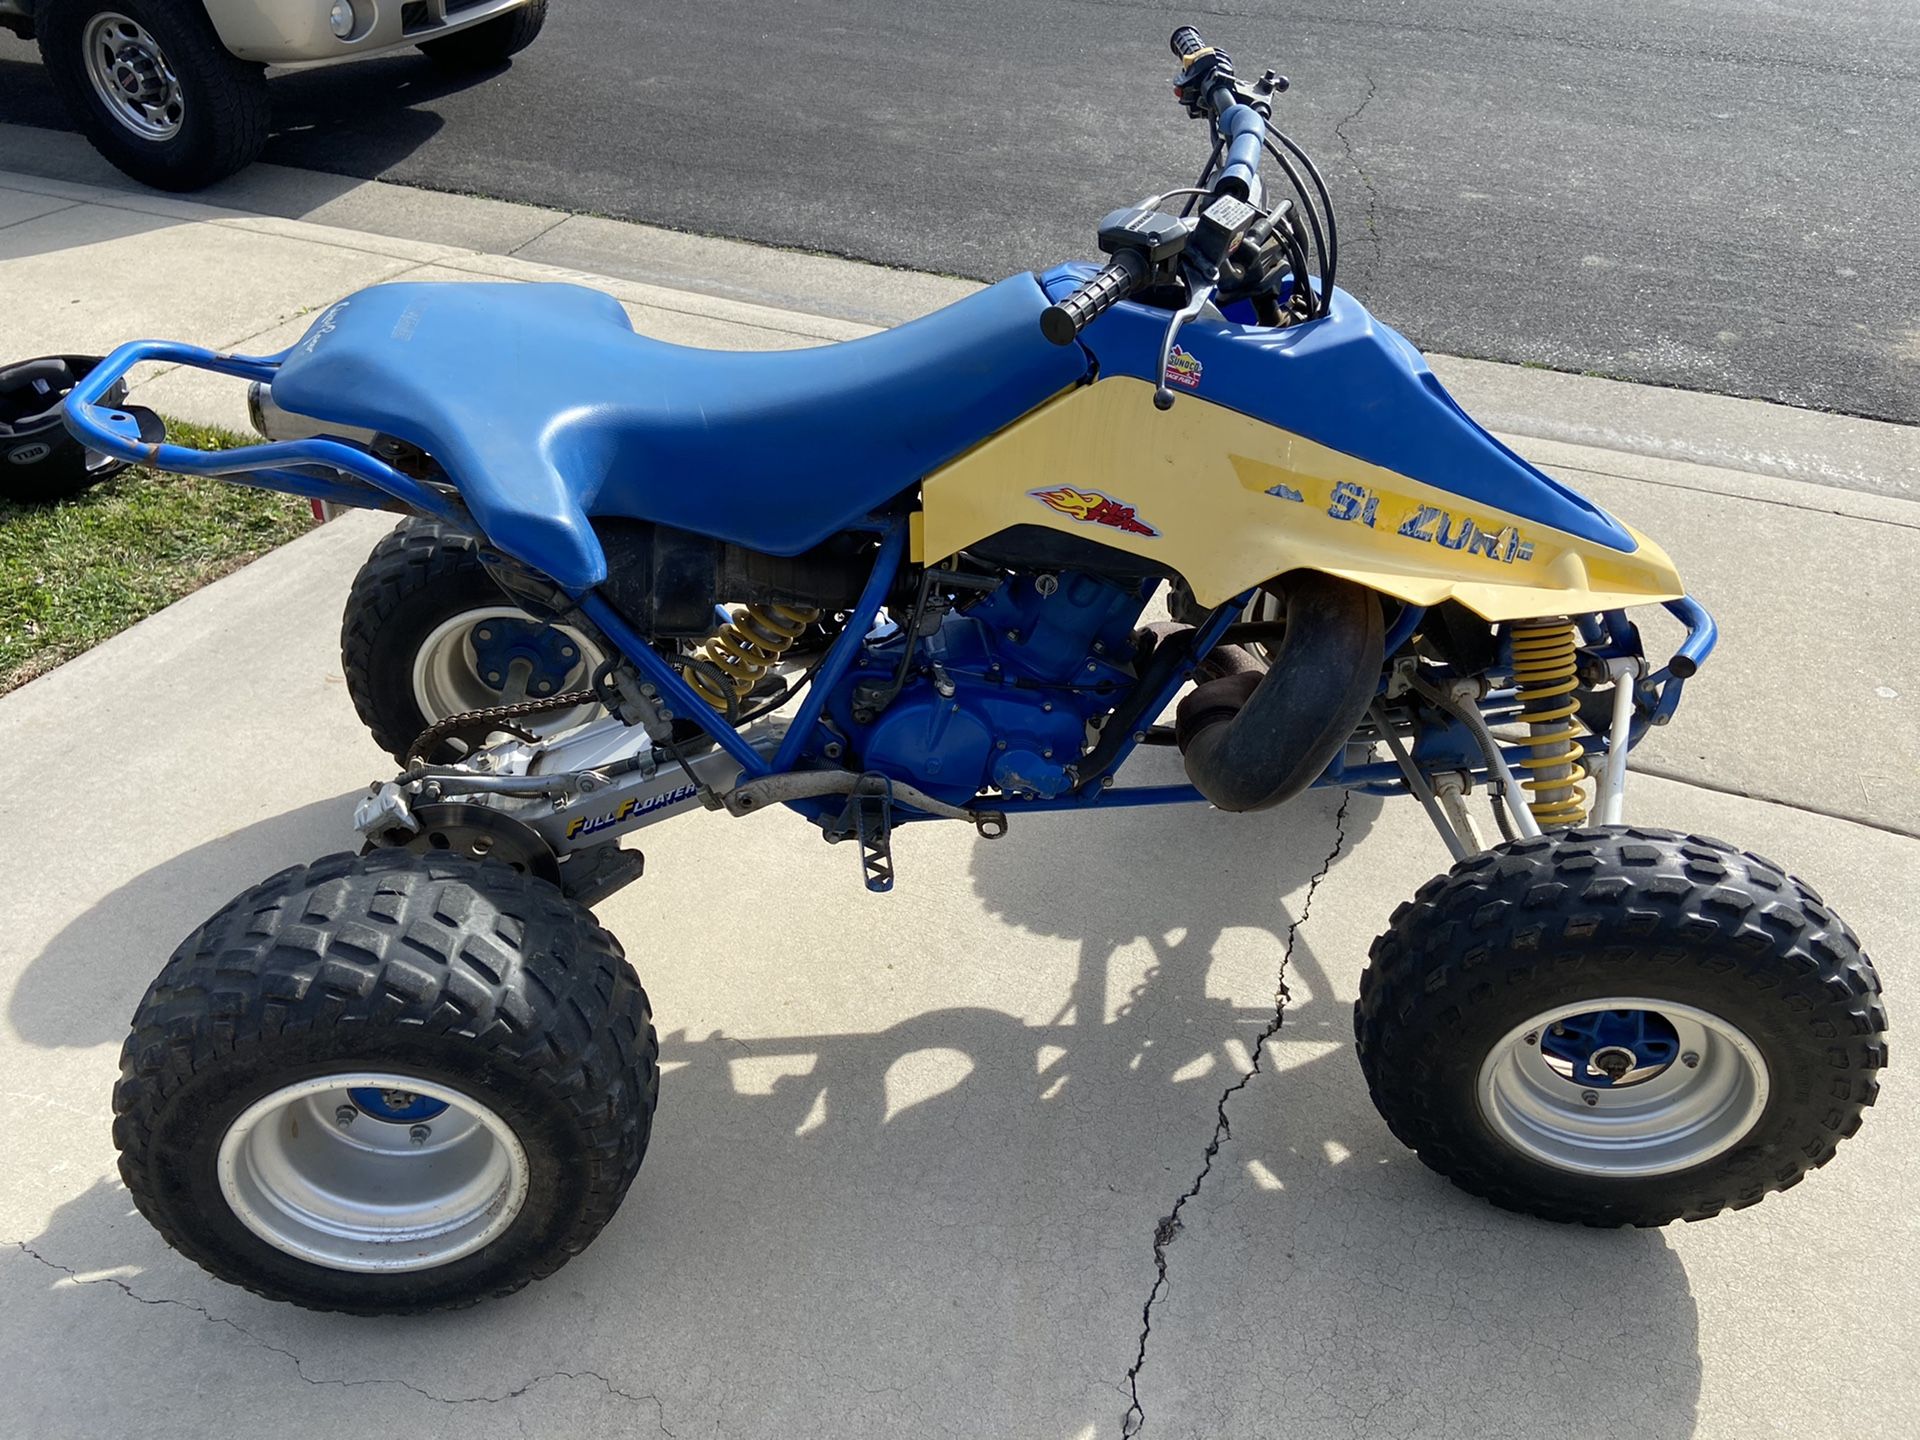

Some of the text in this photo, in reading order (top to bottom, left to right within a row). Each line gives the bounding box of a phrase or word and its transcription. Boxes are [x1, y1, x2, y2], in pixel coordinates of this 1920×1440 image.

[1170, 355, 1200, 371] SUNOCO
[13, 447, 43, 460] BELL
[566, 783, 697, 840] FULL FLOATER
